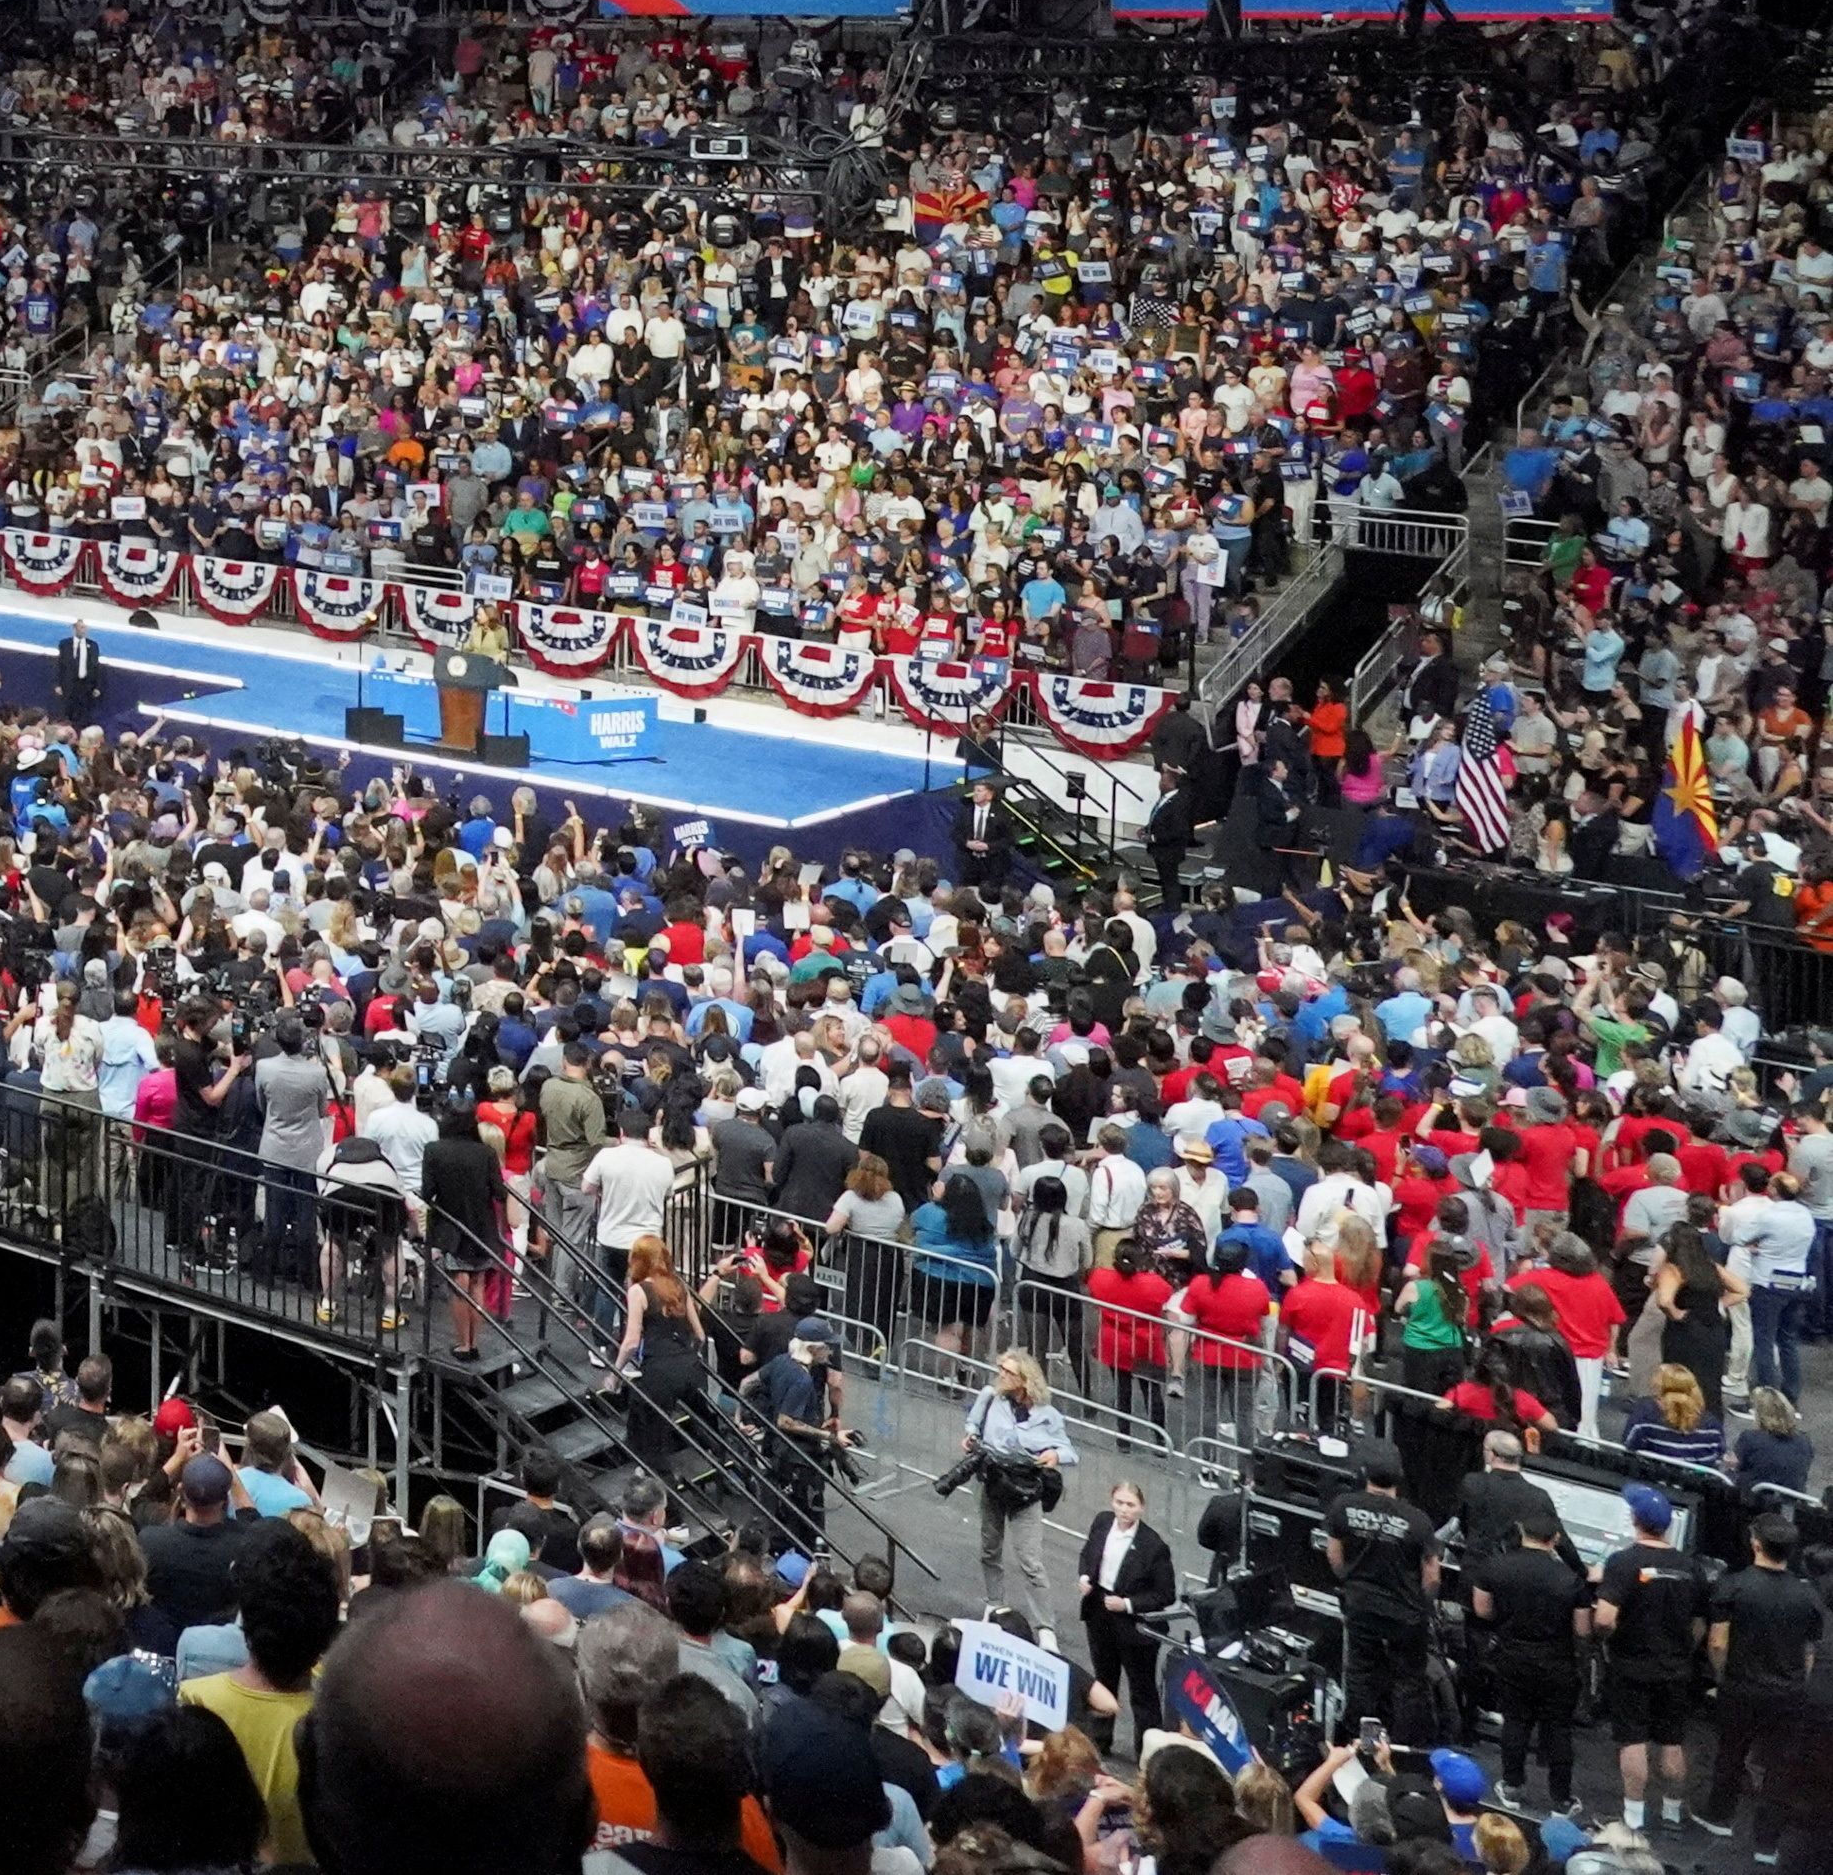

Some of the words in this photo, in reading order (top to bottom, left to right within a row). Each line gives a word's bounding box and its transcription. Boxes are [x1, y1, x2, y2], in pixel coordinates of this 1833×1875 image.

[590, 710, 645, 736] HARRIS
[600, 734, 637, 748] WALZ
[673, 820, 709, 842] HARRIS
[1345, 1507, 1409, 1531] SOUND
[980, 1641, 1013, 1657] WHEN
[975, 1651, 1012, 1689] WE
[1017, 1665, 1057, 1709] WIN
